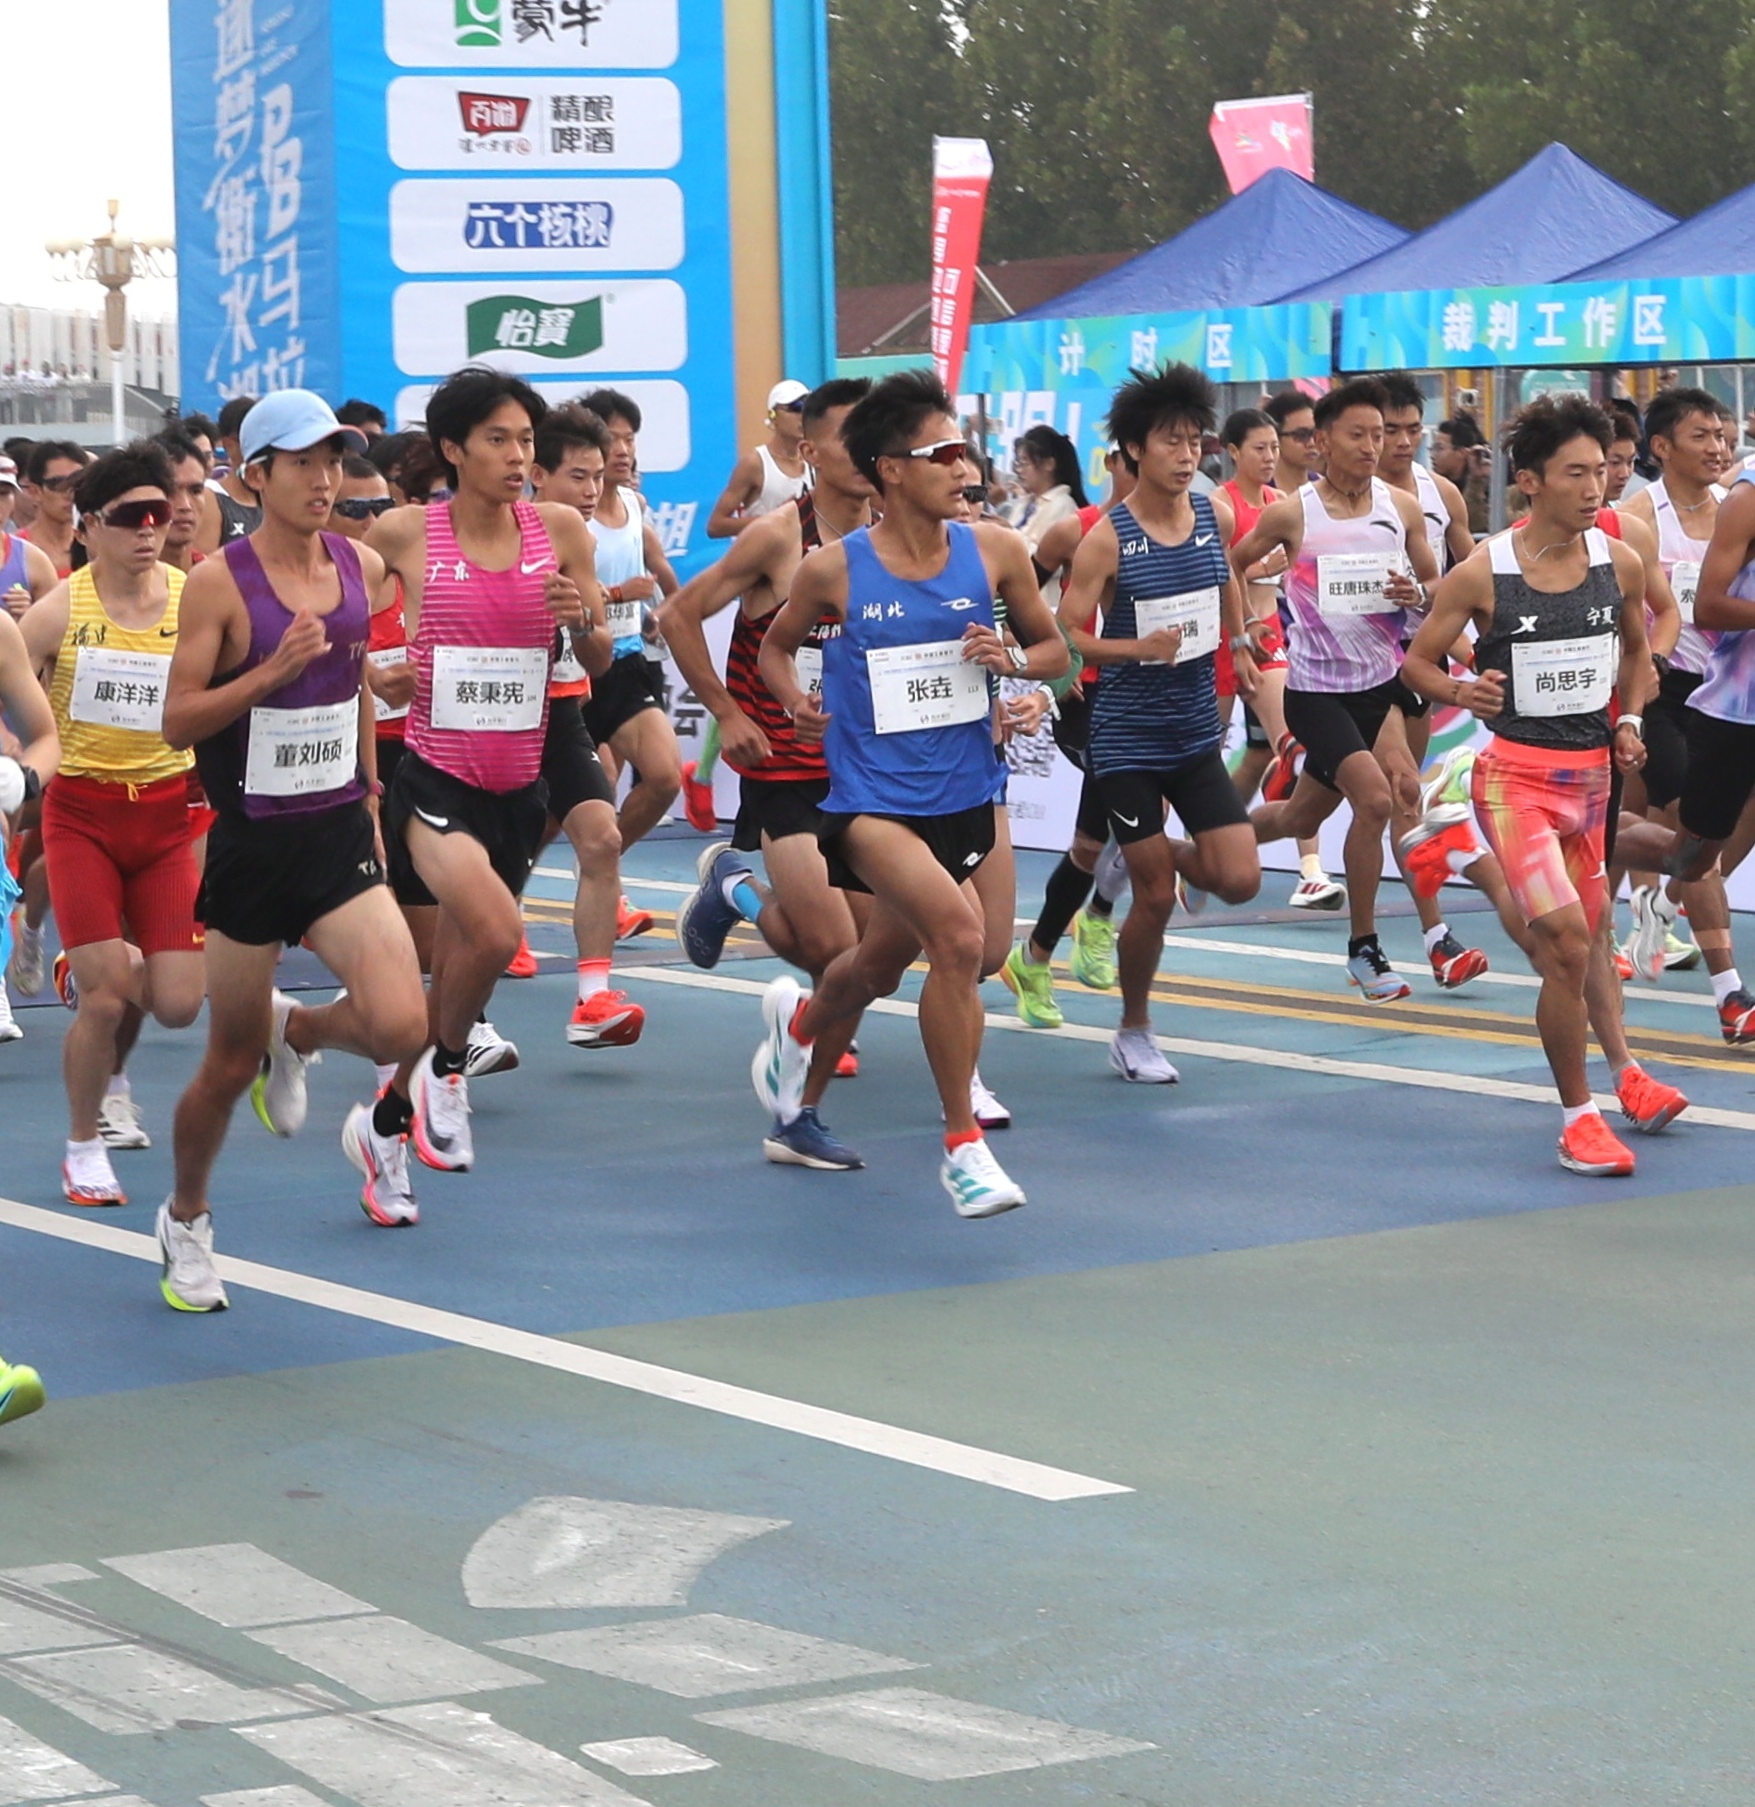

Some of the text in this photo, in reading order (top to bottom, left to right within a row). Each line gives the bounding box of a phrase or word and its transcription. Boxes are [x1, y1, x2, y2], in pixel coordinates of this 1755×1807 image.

[550, 95, 615, 123] 精酿
[550, 126, 615, 154] 啤酒
[468, 203, 610, 247] 六个核桃
[495, 307, 576, 347] 怡寶
[1441, 294, 1667, 352] 裁判工作区
[428, 559, 470, 582] 广东
[862, 600, 906, 622] 湖北
[1586, 605, 1615, 626] 宁夏
[94, 680, 159, 707] 康洋洋
[456, 680, 524, 704] 蔡秉宪
[907, 676, 954, 703] 张垚
[1536, 668, 1597, 693] 尚思宇
[273, 738, 342, 768] 董刘硕
